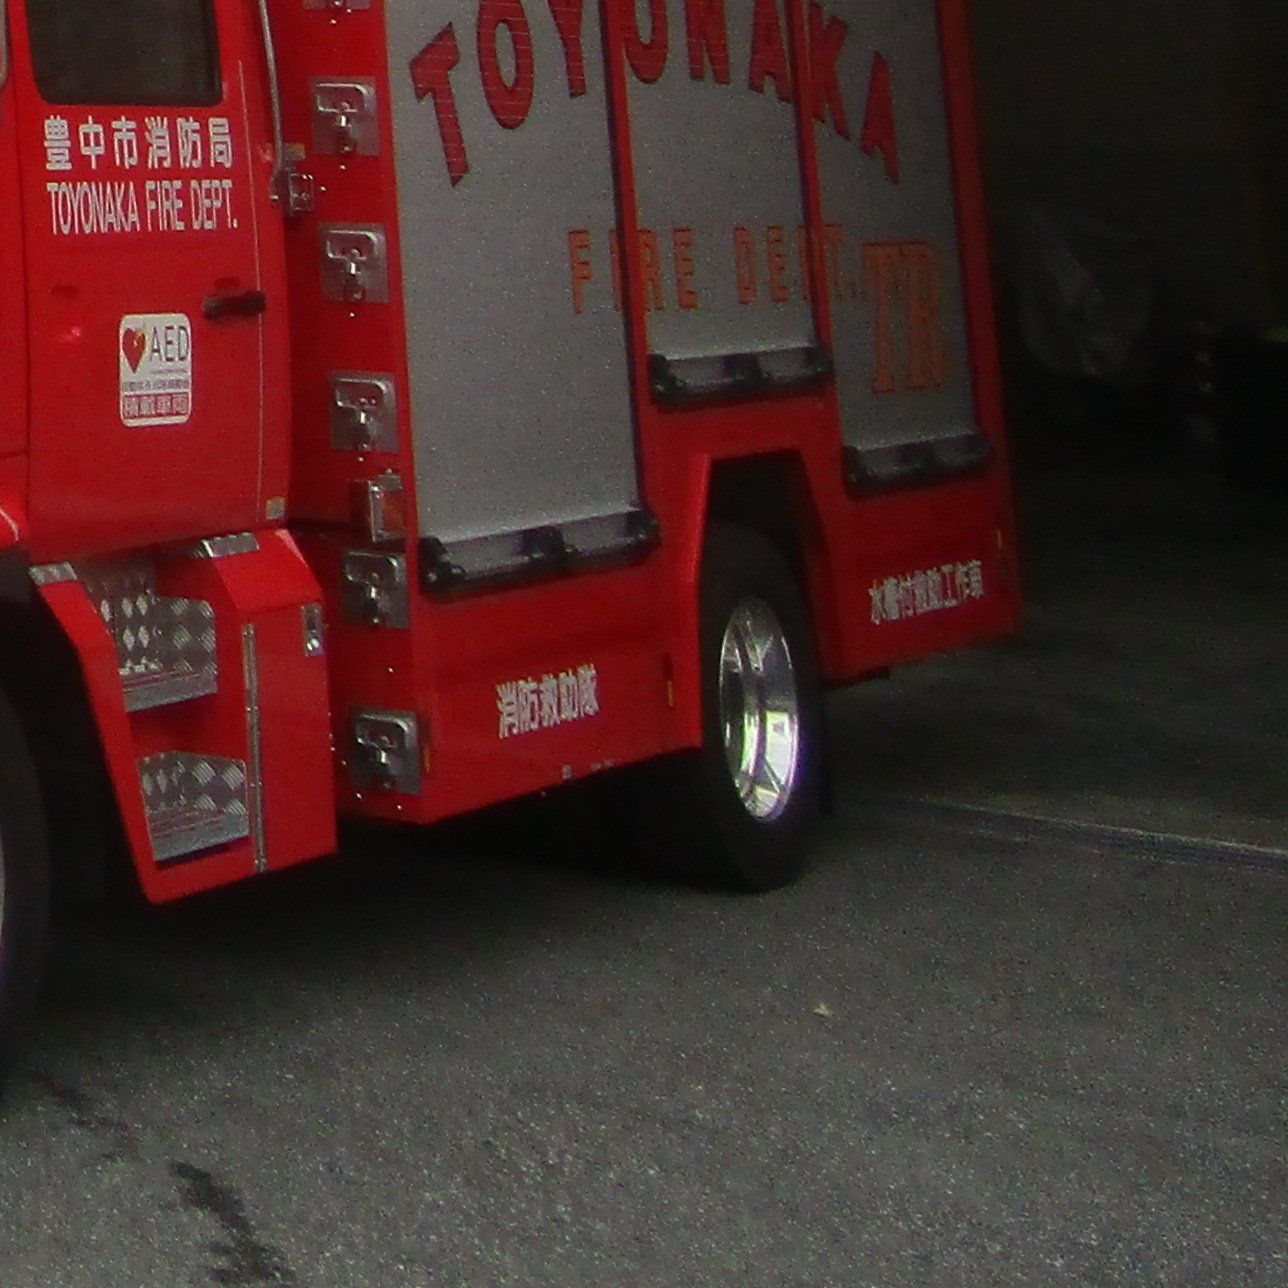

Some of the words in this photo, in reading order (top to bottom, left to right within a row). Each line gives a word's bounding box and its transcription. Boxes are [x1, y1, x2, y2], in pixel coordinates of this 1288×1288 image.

[43, 114, 234, 171] 豊中市消防局
[47, 182, 140, 235] TOYONAKA
[146, 180, 185, 232] FIRE
[190, 179, 238, 230] DEPT.
[567, 228, 697, 313] FIRE
[150, 325, 188, 362] AED
[496, 663, 599, 739] 消防救助隊
